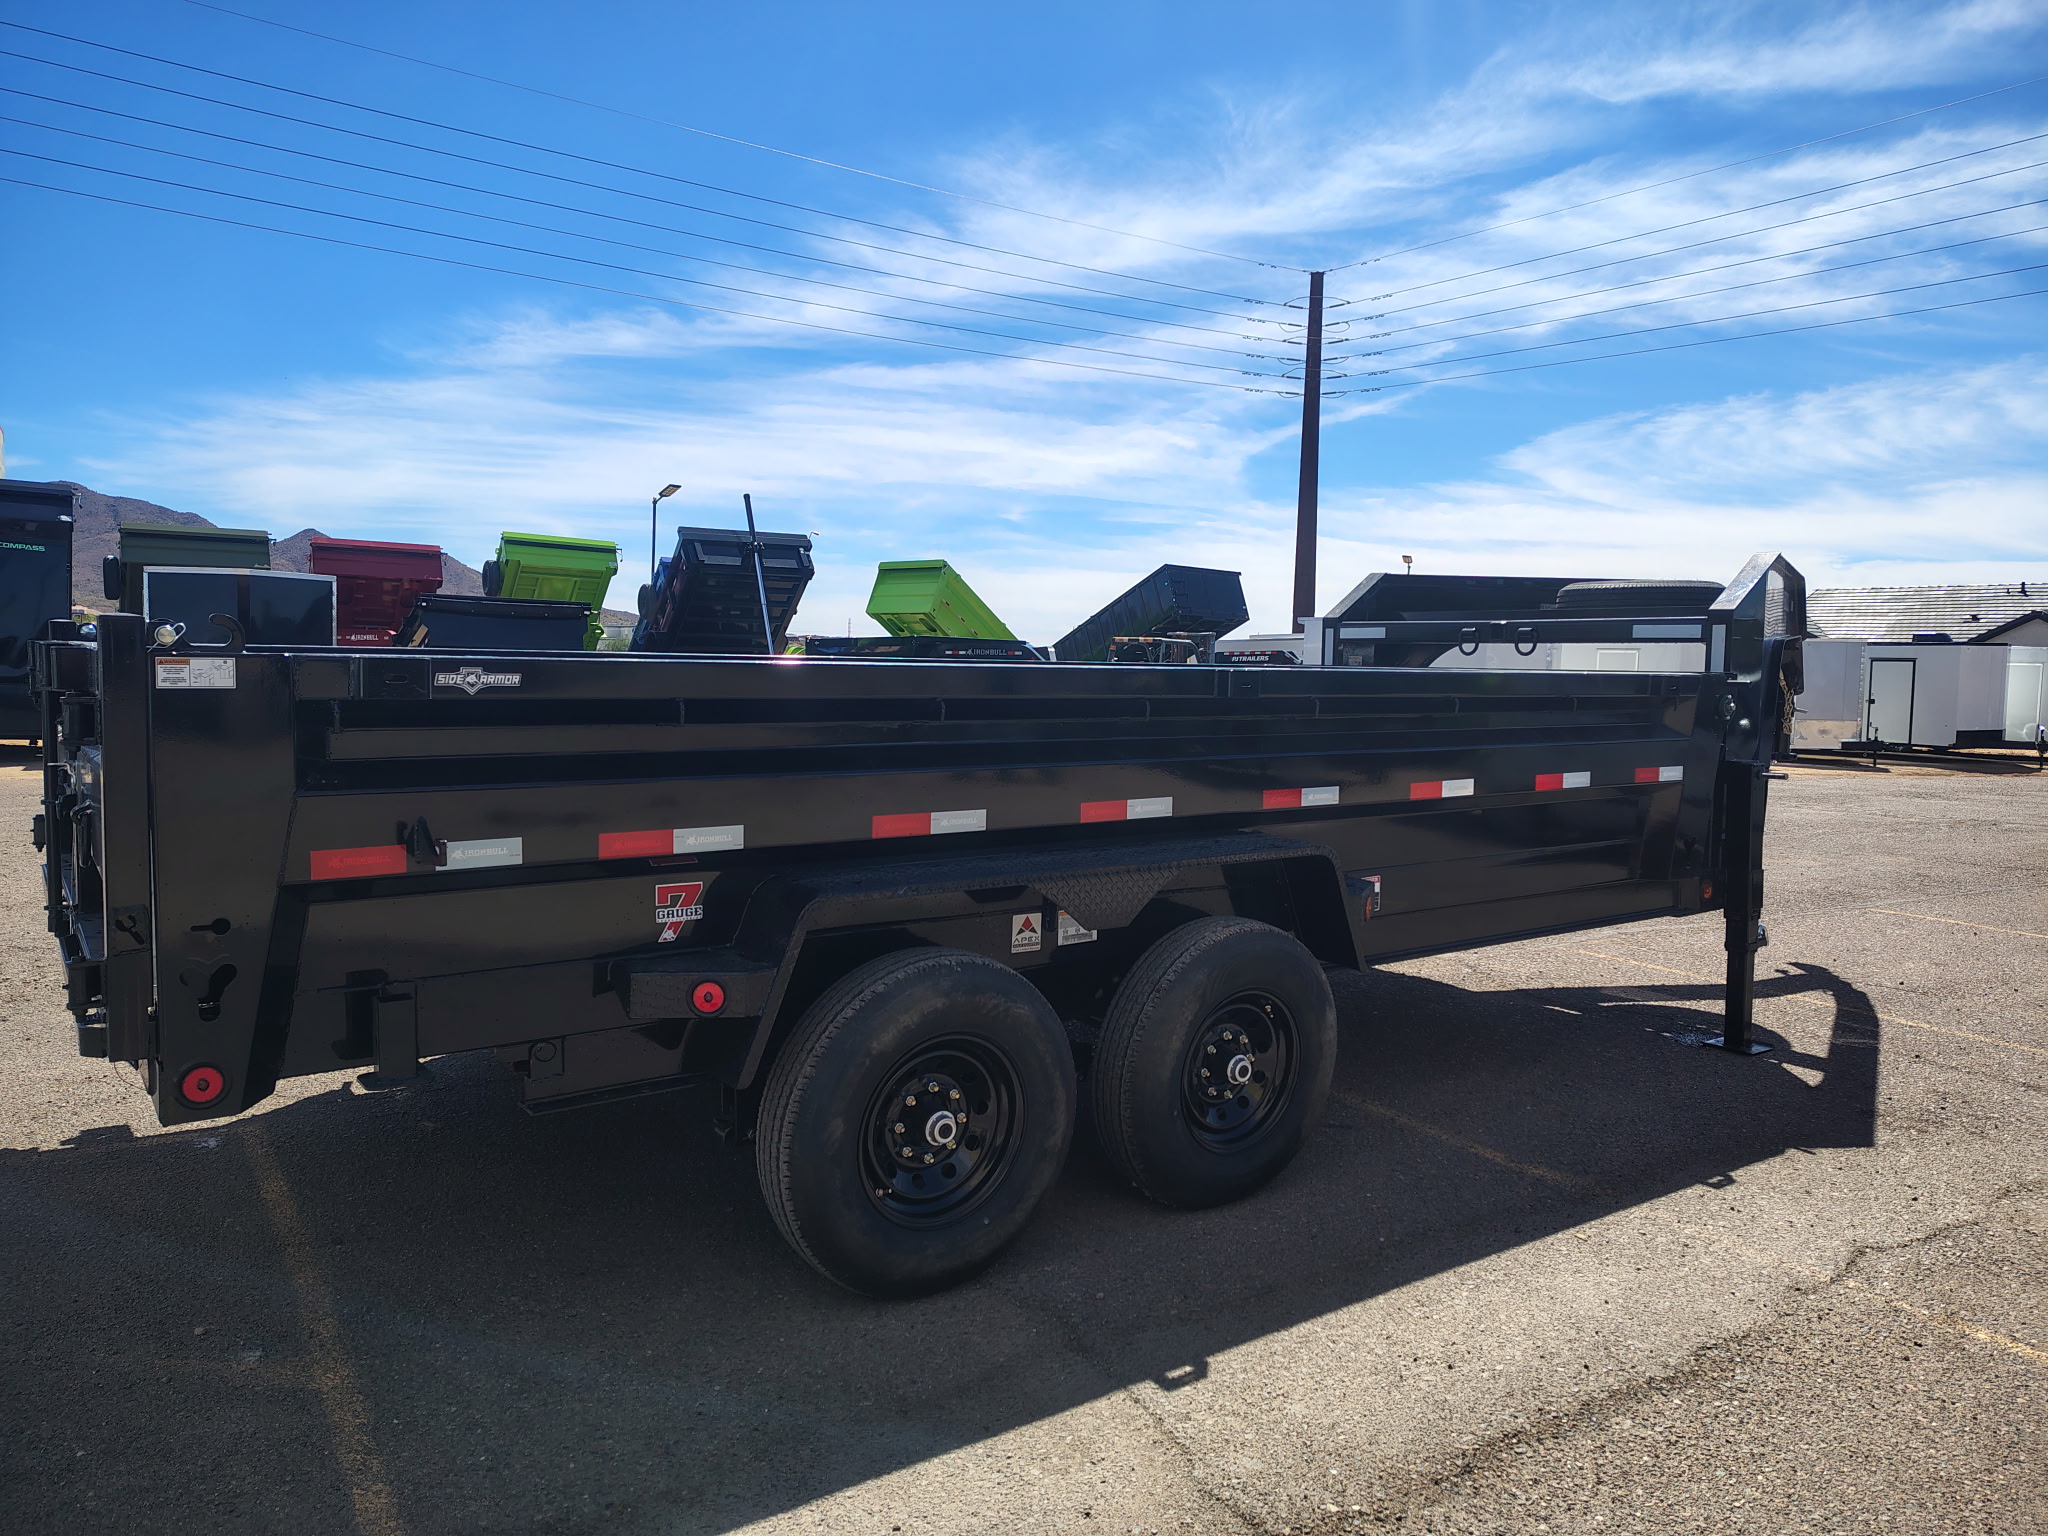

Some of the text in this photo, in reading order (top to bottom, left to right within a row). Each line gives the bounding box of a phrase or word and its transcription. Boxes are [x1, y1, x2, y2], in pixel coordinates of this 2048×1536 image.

[973, 648, 1007, 656] IRONBULL
[437, 674, 520, 685] SIDE ARMOR
[464, 847, 509, 857] IRONBULL
[655, 881, 704, 943] 7
[656, 906, 703, 920] GAUGE
[1013, 935, 1040, 944] APEX
